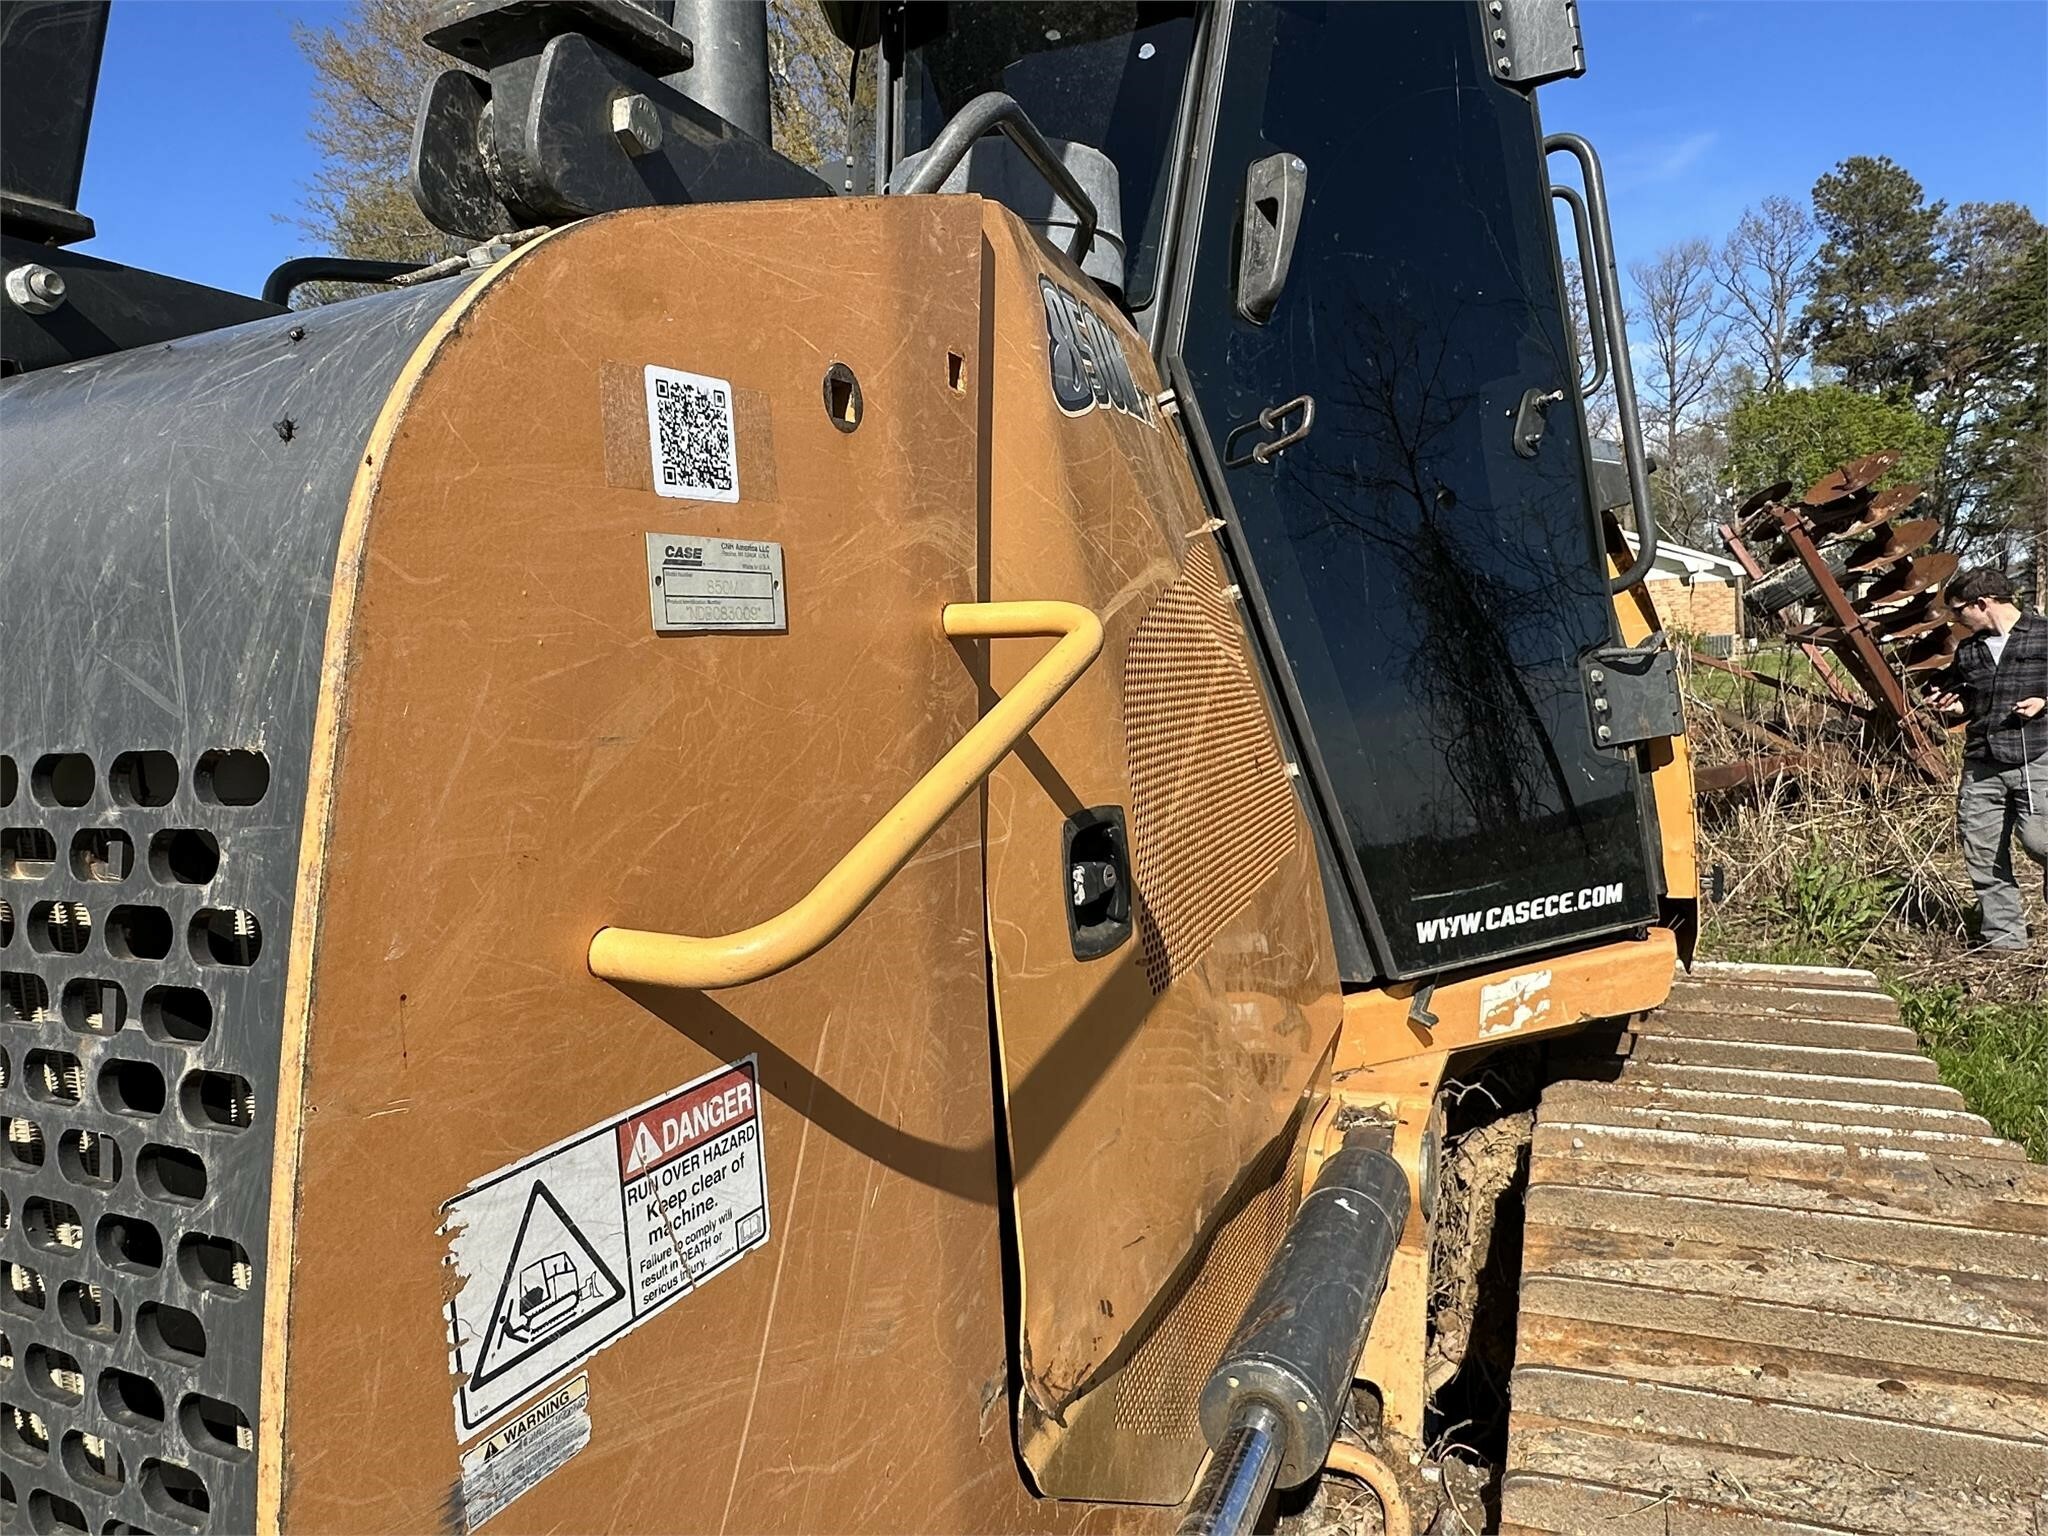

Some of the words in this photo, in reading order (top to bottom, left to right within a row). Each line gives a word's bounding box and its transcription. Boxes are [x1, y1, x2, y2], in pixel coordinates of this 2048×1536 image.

[665, 545, 702, 559] CASE
[720, 542, 734, 550] CNH
[735, 543, 758, 552] America
[758, 545, 770, 553] LLC
[1416, 882, 1623, 944] WWW.CASECE.COM
[662, 1081, 753, 1153] DANGER
[627, 1175, 659, 1206] RUN
[662, 1154, 700, 1187] OVER
[703, 1125, 755, 1165] HAZARD
[646, 1188, 687, 1222] Keep
[691, 1165, 727, 1196] clear
[731, 1151, 745, 1174] of
[640, 1246, 672, 1274] Failure
[685, 1219, 717, 1246] comply
[718, 1207, 733, 1224] will
[648, 1196, 718, 1245] machine.
[640, 1264, 668, 1290] result
[669, 1259, 679, 1272] in
[680, 1236, 713, 1265] DEATH
[713, 1231, 723, 1246] or
[642, 1275, 679, 1305] serious
[503, 1391, 570, 1444] WARNING
